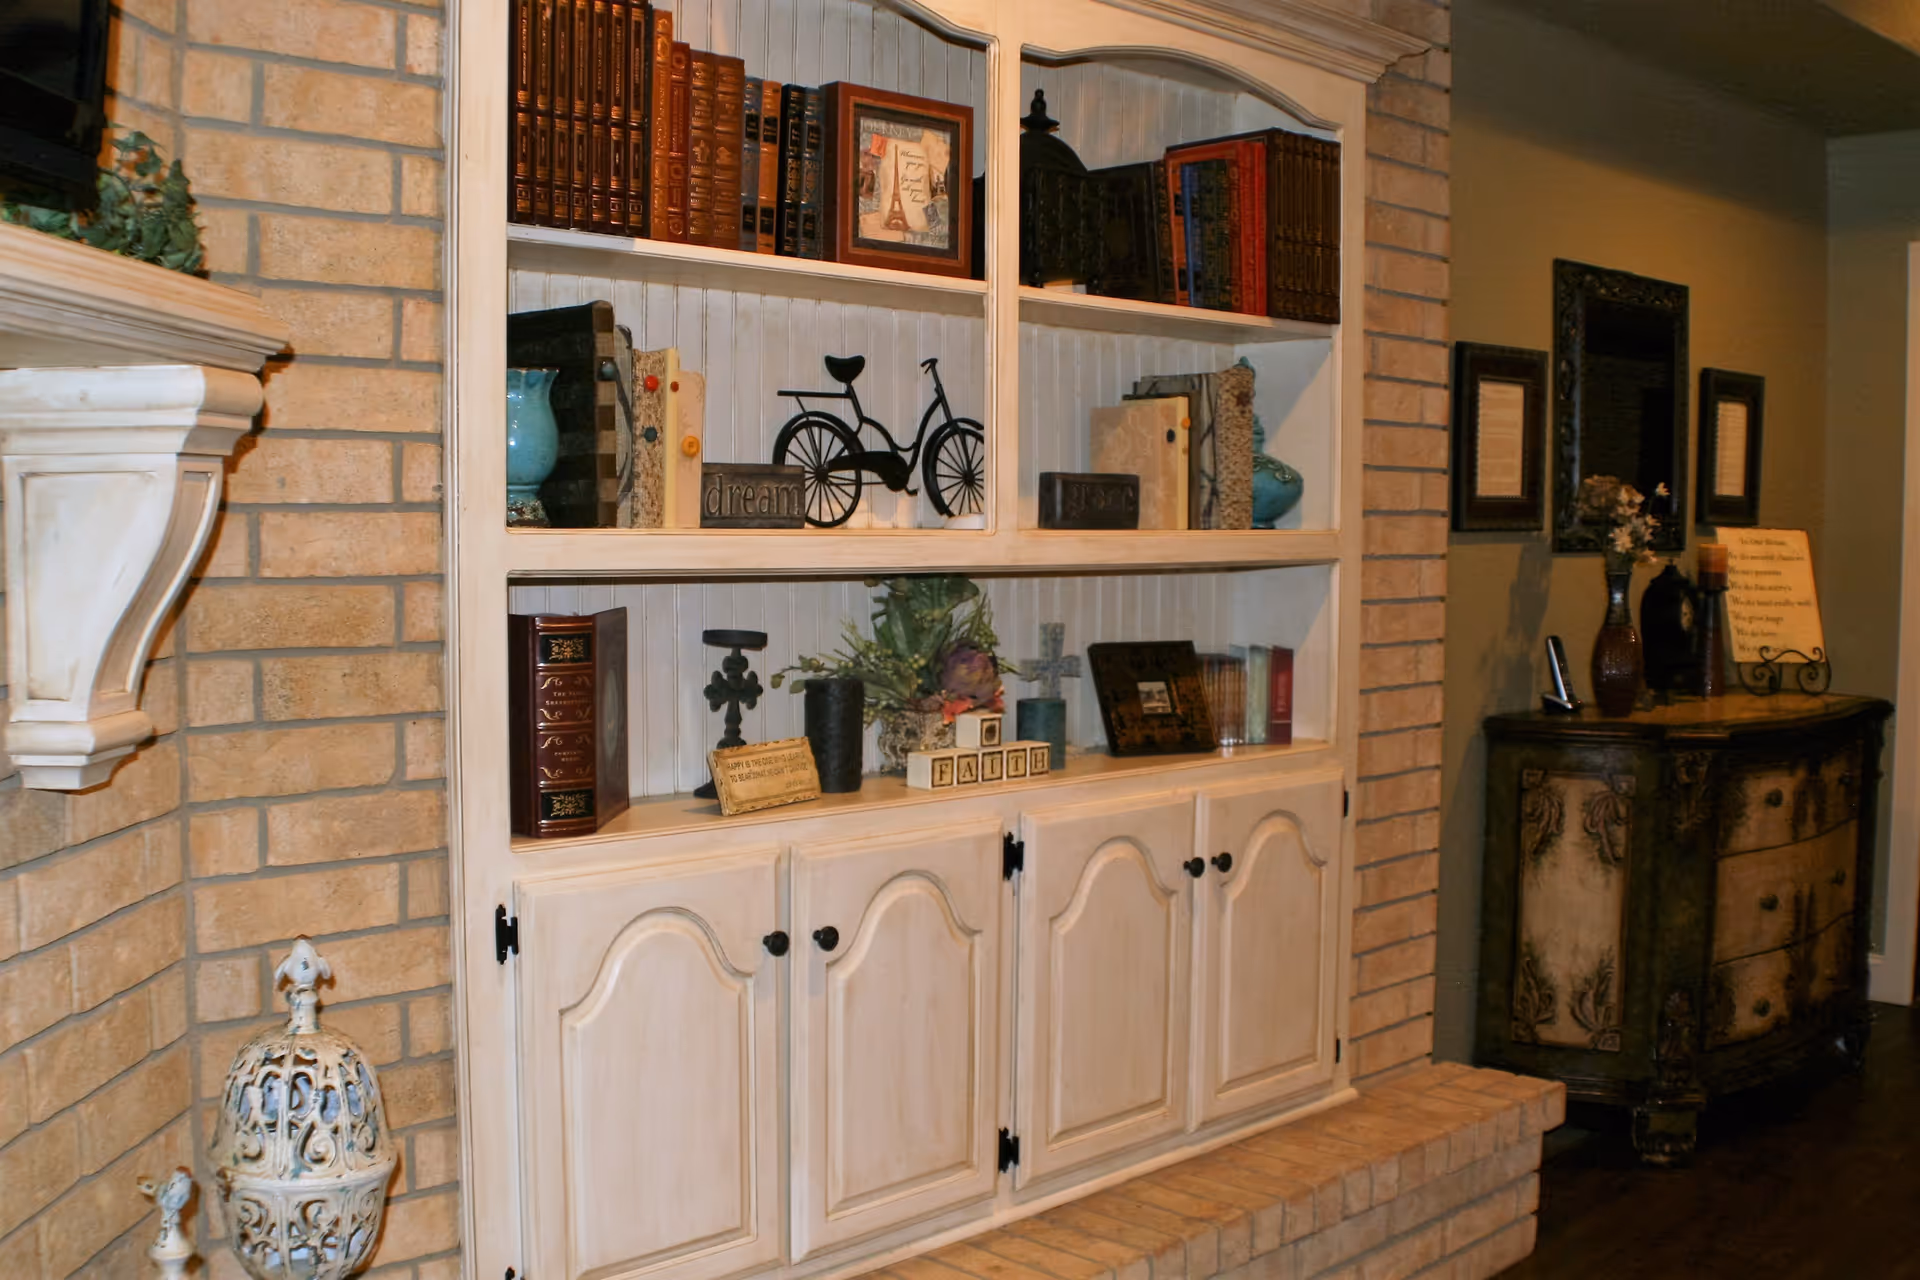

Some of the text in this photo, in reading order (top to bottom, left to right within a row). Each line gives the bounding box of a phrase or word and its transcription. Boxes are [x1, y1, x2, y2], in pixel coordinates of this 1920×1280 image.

[704, 473, 802, 517] dream
[727, 760, 744, 771] HAPPY
[938, 751, 1047, 782] FAITH
